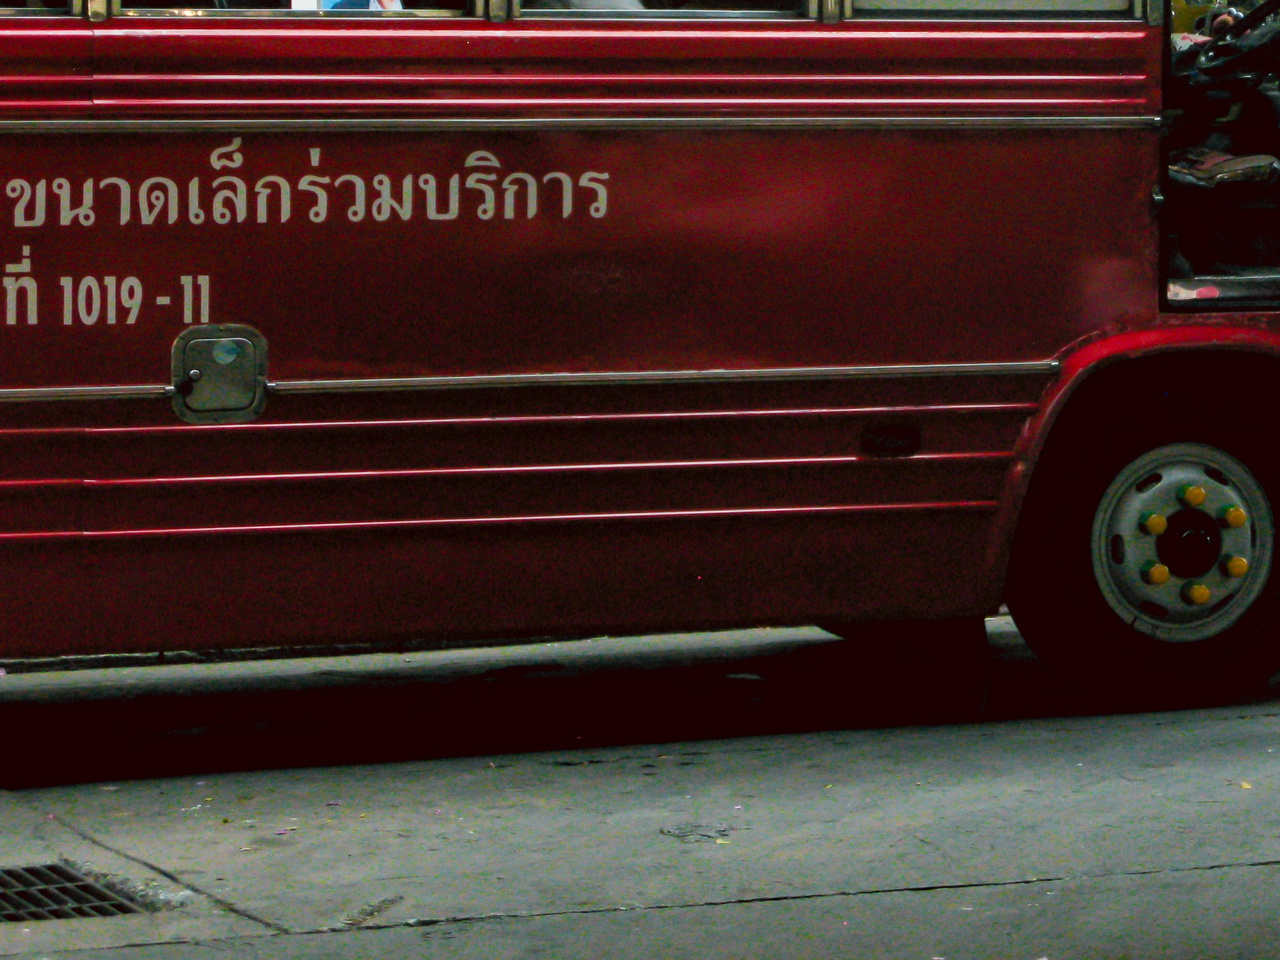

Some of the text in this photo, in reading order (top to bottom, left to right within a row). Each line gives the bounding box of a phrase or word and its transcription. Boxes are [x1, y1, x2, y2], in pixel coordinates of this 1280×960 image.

[5, 137, 610, 227] ขนาดเล็กร่วมบริการ
[2, 245, 38, 325] ที่
